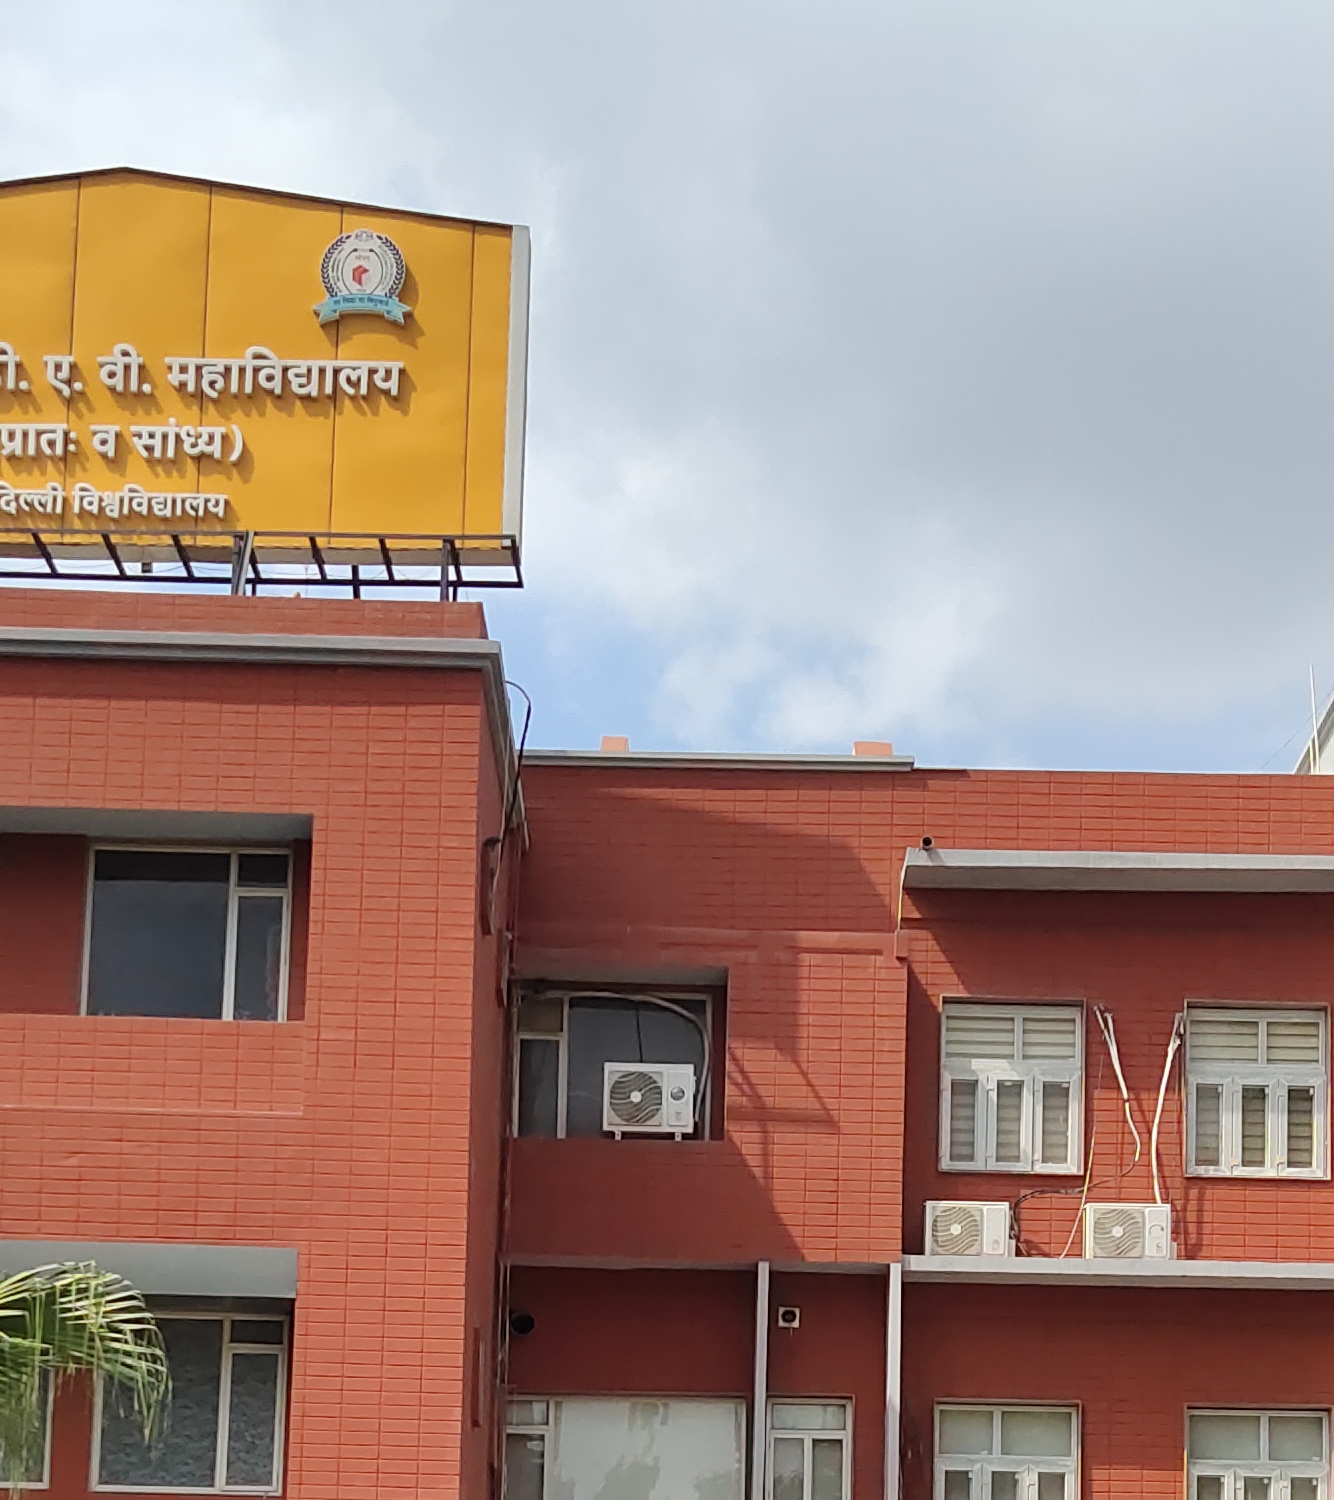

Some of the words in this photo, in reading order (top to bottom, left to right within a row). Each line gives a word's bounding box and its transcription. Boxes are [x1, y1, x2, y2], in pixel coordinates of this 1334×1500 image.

[43, 355, 84, 399] ए.
[97, 343, 152, 394] वी.
[165, 345, 404, 398] महाविद्यालय
[90, 424, 121, 458] व
[130, 417, 244, 463] सांध्य)
[71, 482, 229, 519] विश्वविद्यालय
